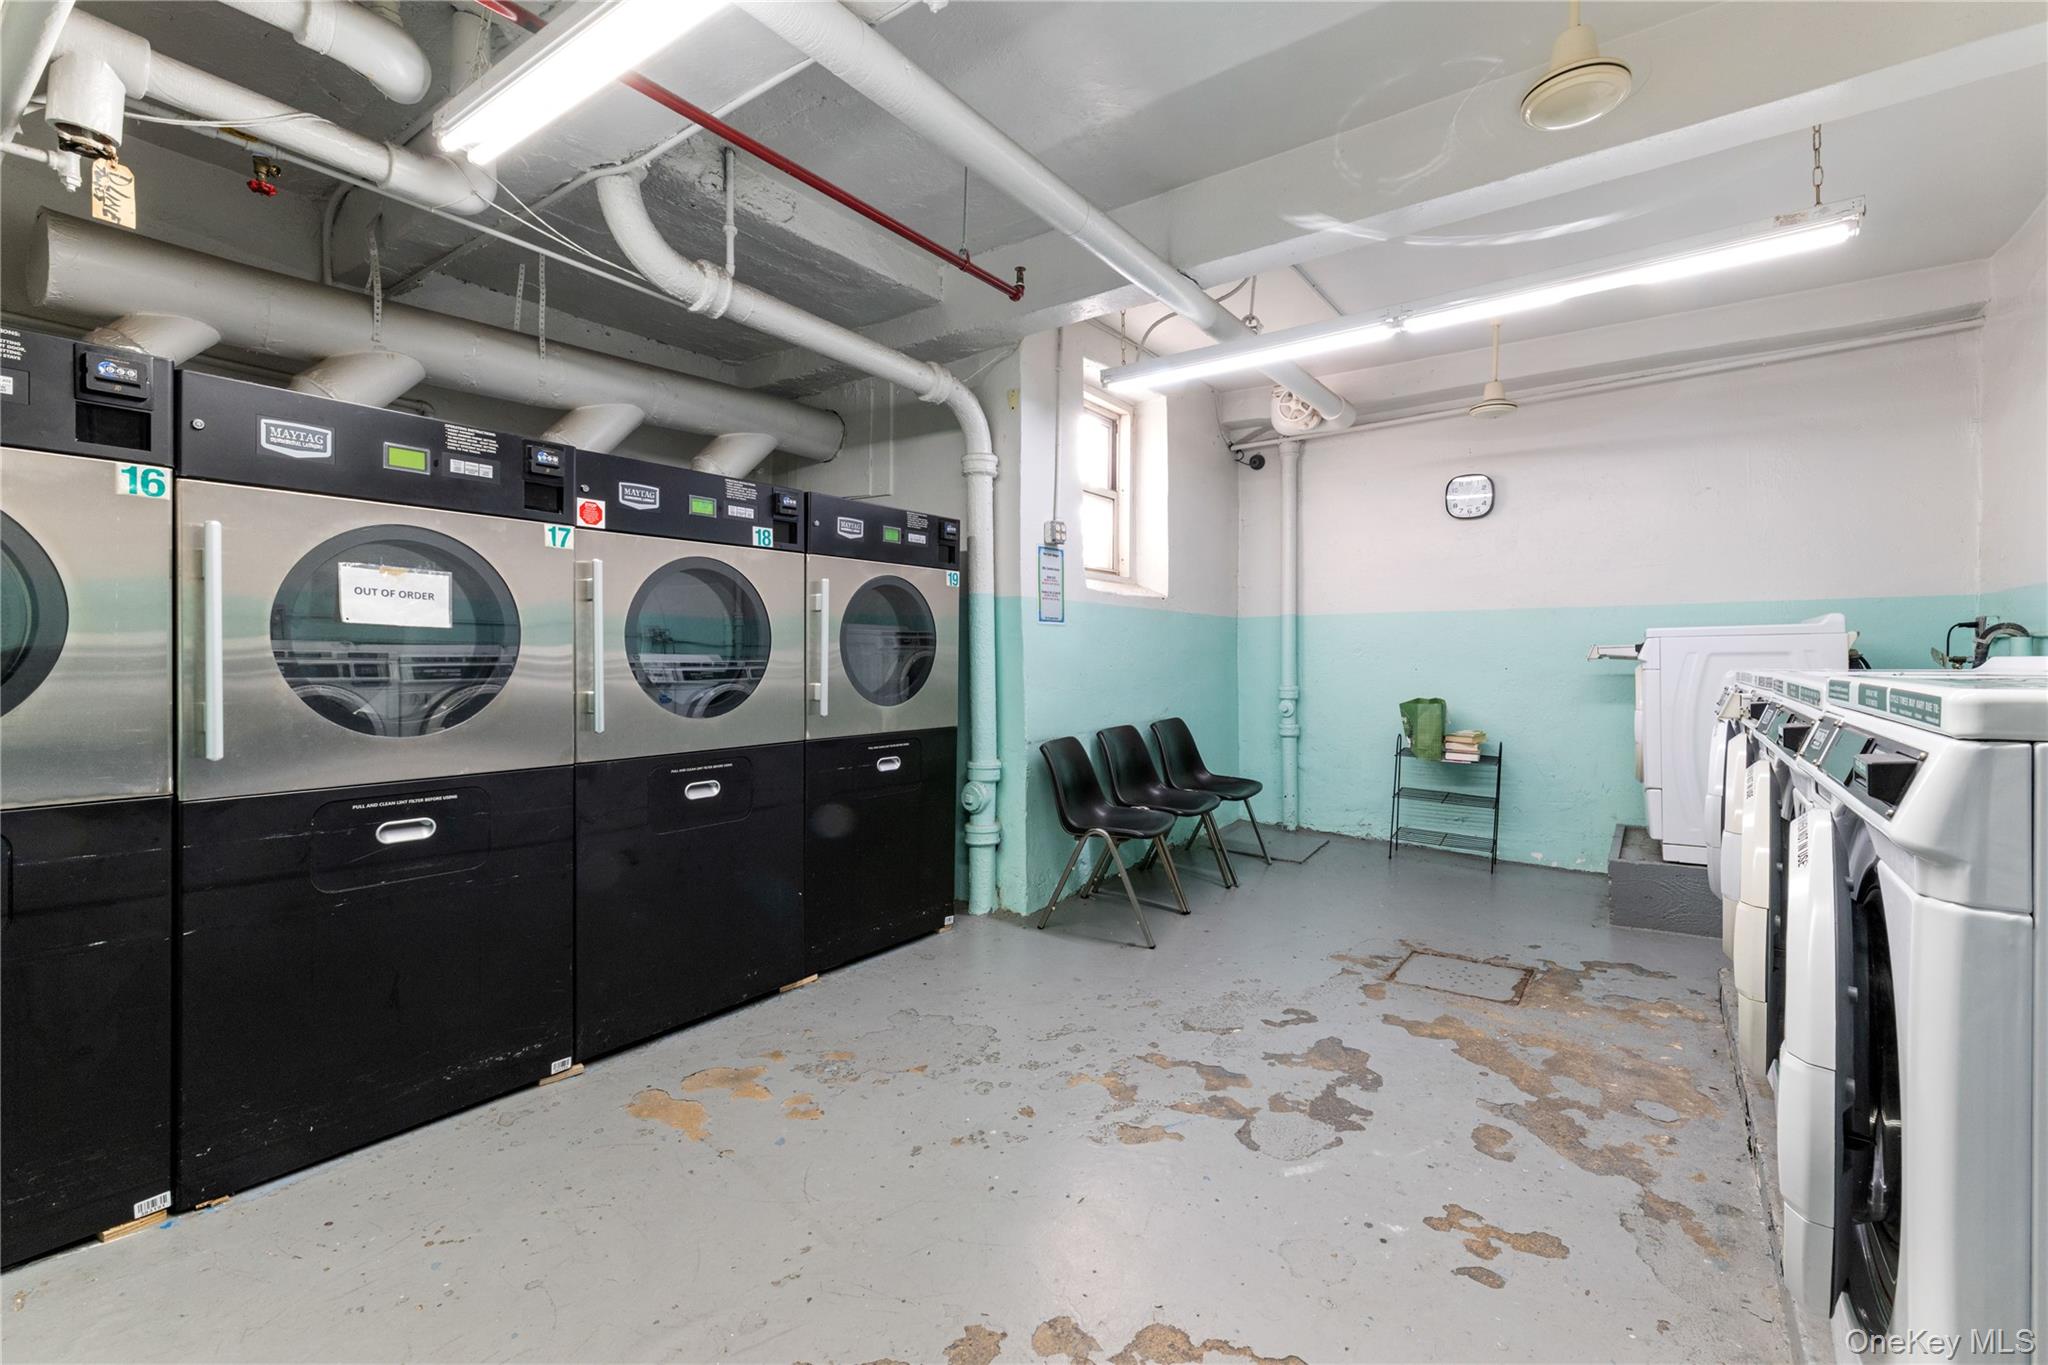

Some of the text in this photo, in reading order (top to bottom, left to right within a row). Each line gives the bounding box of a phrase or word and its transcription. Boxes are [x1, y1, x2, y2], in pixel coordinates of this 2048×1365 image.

[269, 426, 324, 444] MAYTAG
[121, 466, 166, 497] 16
[624, 487, 655, 499] MAYTAG
[840, 520, 861, 530] MAYTAG
[548, 526, 572, 548] 17
[755, 528, 772, 547] 18
[947, 572, 959, 586] 19
[353, 586, 436, 601] OUT OF ORDER
[1798, 849, 1808, 868] USE
